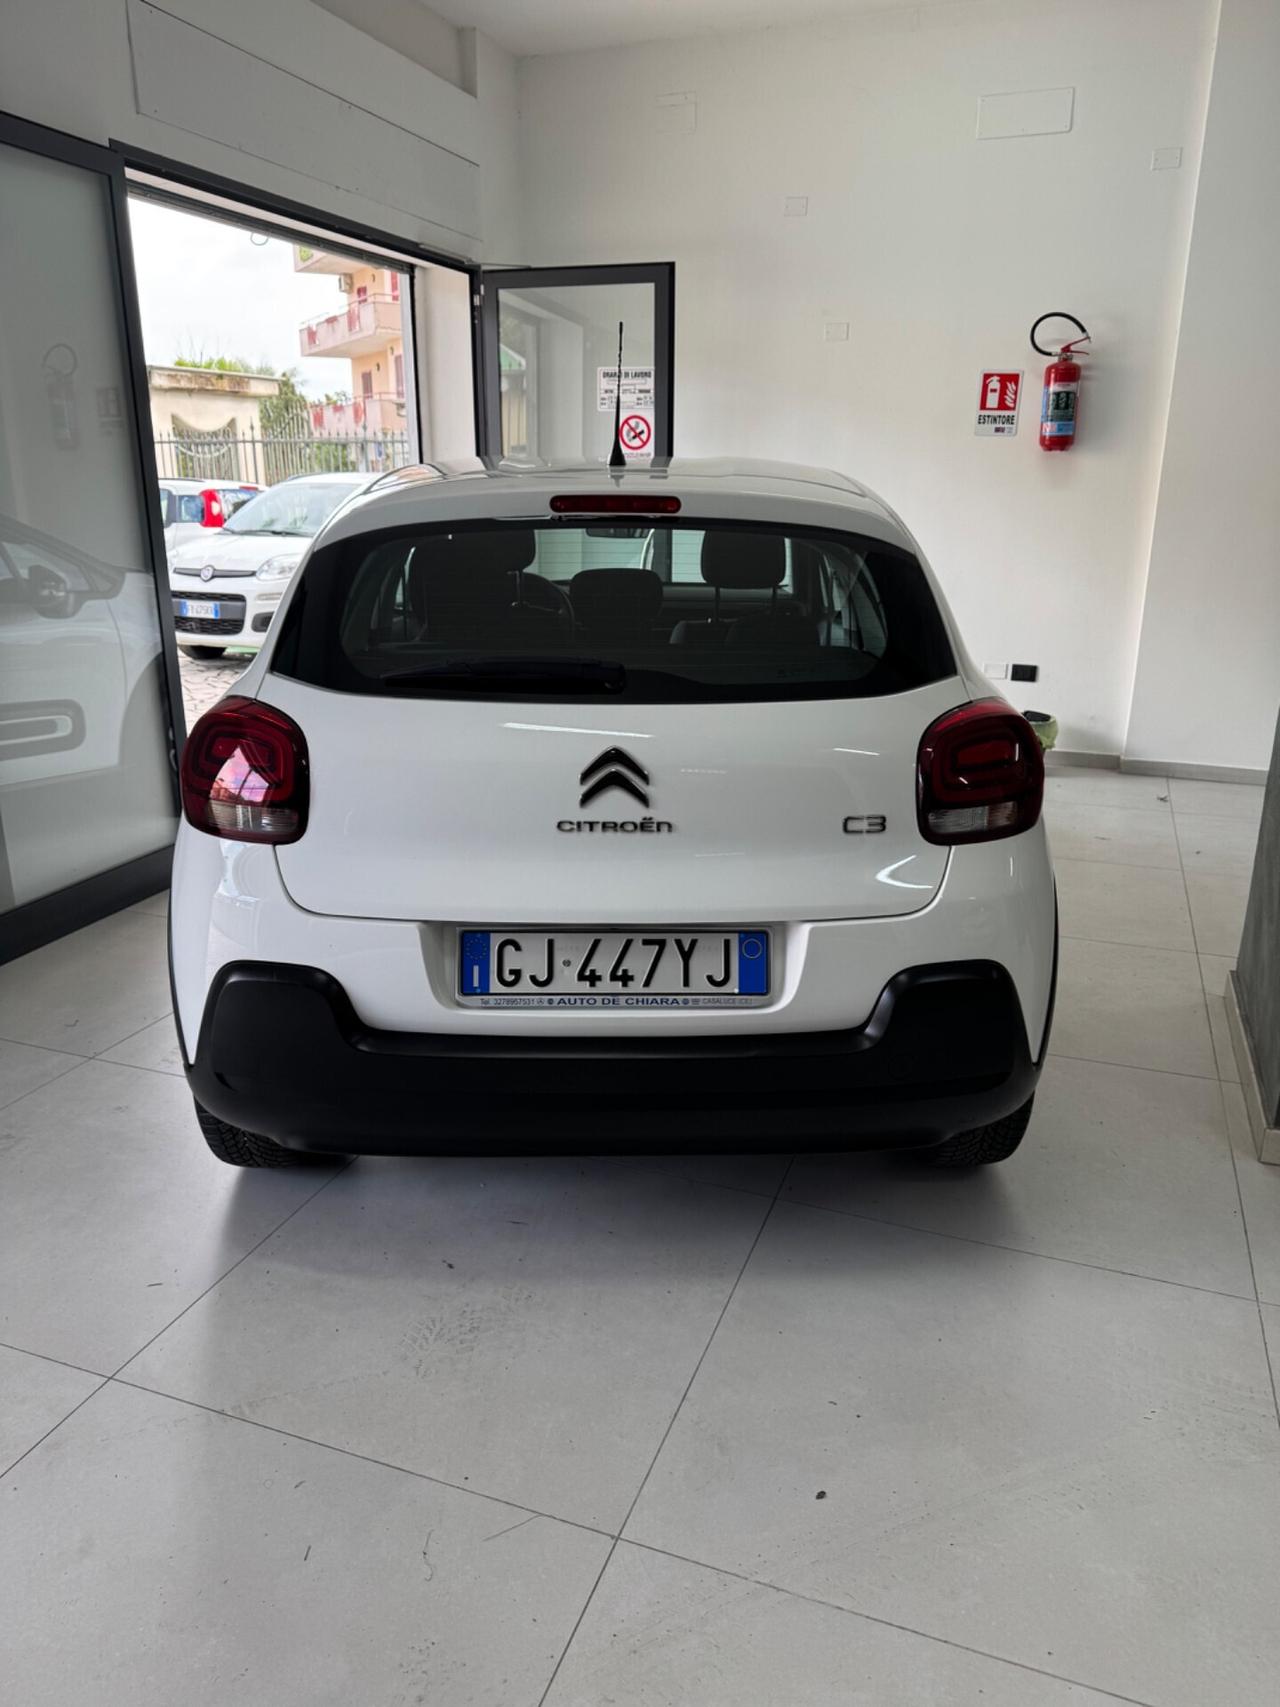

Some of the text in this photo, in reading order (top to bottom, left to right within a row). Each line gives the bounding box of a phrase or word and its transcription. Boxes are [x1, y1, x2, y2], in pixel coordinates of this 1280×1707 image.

[977, 414, 1015, 425] ESTINTORE
[842, 815, 887, 834] C3
[556, 997, 597, 1006] AUTO
[601, 997, 620, 1006] DE
[624, 997, 681, 1006] CHIARA
